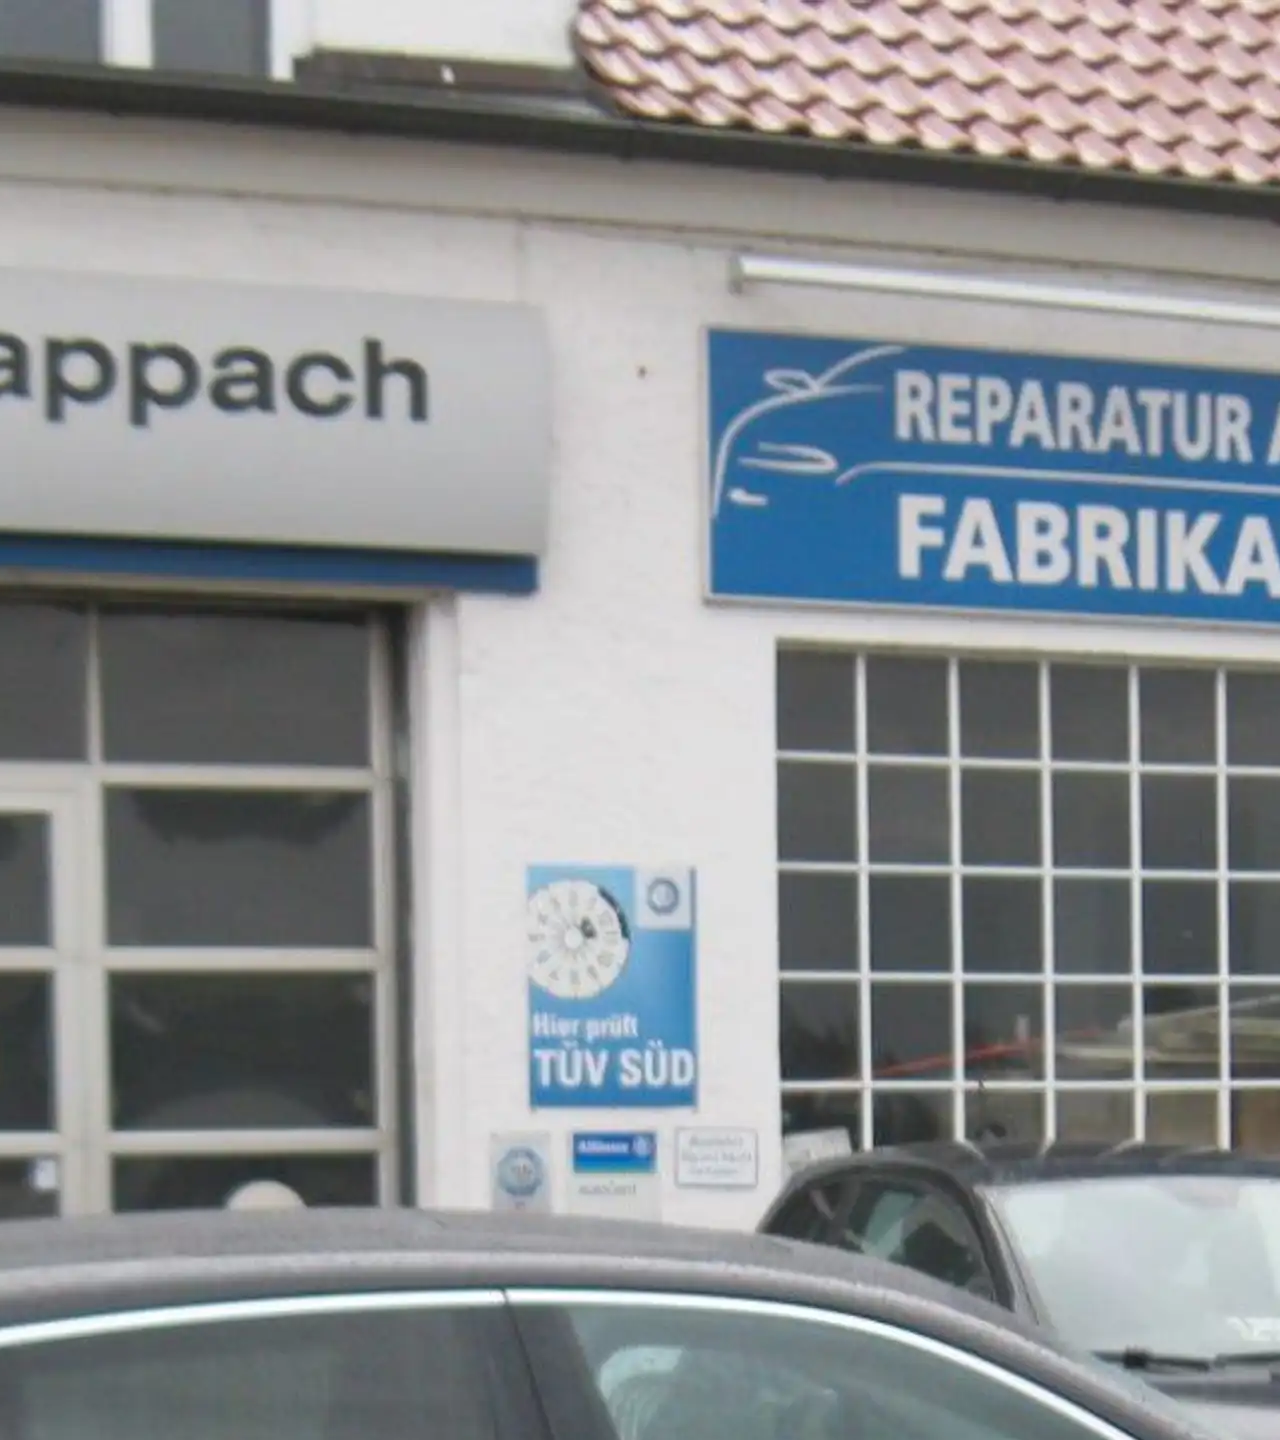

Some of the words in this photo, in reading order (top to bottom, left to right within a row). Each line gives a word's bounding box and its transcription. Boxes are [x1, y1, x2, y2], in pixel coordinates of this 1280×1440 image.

[893, 369, 1253, 464] REPARATUR
[533, 1012, 579, 1036] Hier
[585, 1013, 638, 1043] prüft
[533, 1040, 610, 1088] TÜV
[620, 1039, 695, 1088] SÜD
